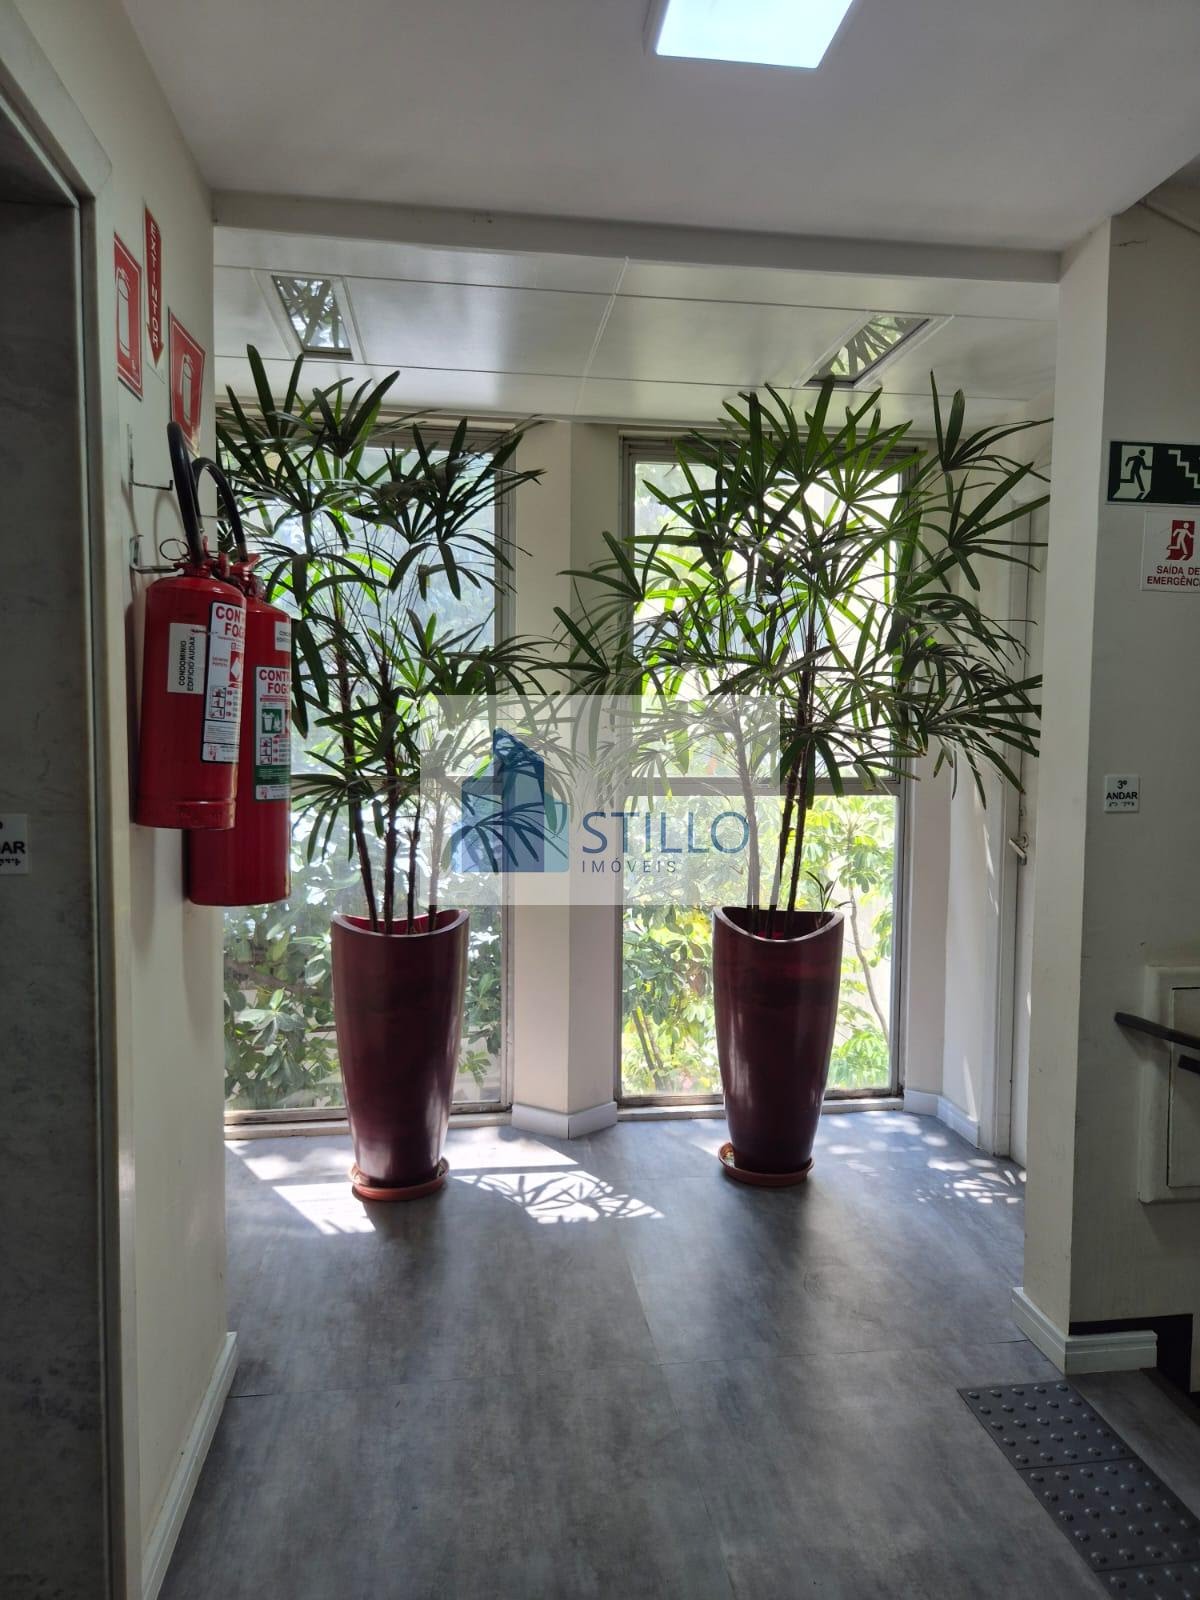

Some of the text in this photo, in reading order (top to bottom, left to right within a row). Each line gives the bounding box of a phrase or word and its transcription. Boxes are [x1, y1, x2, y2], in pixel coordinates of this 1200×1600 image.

[149, 222, 160, 350] EXTINTOR
[1156, 563, 1200, 576] SAÍDA DE
[1146, 575, 1200, 587] EMERGÊNC
[267, 682, 289, 694] FOG
[1105, 791, 1138, 800] ANDAR
